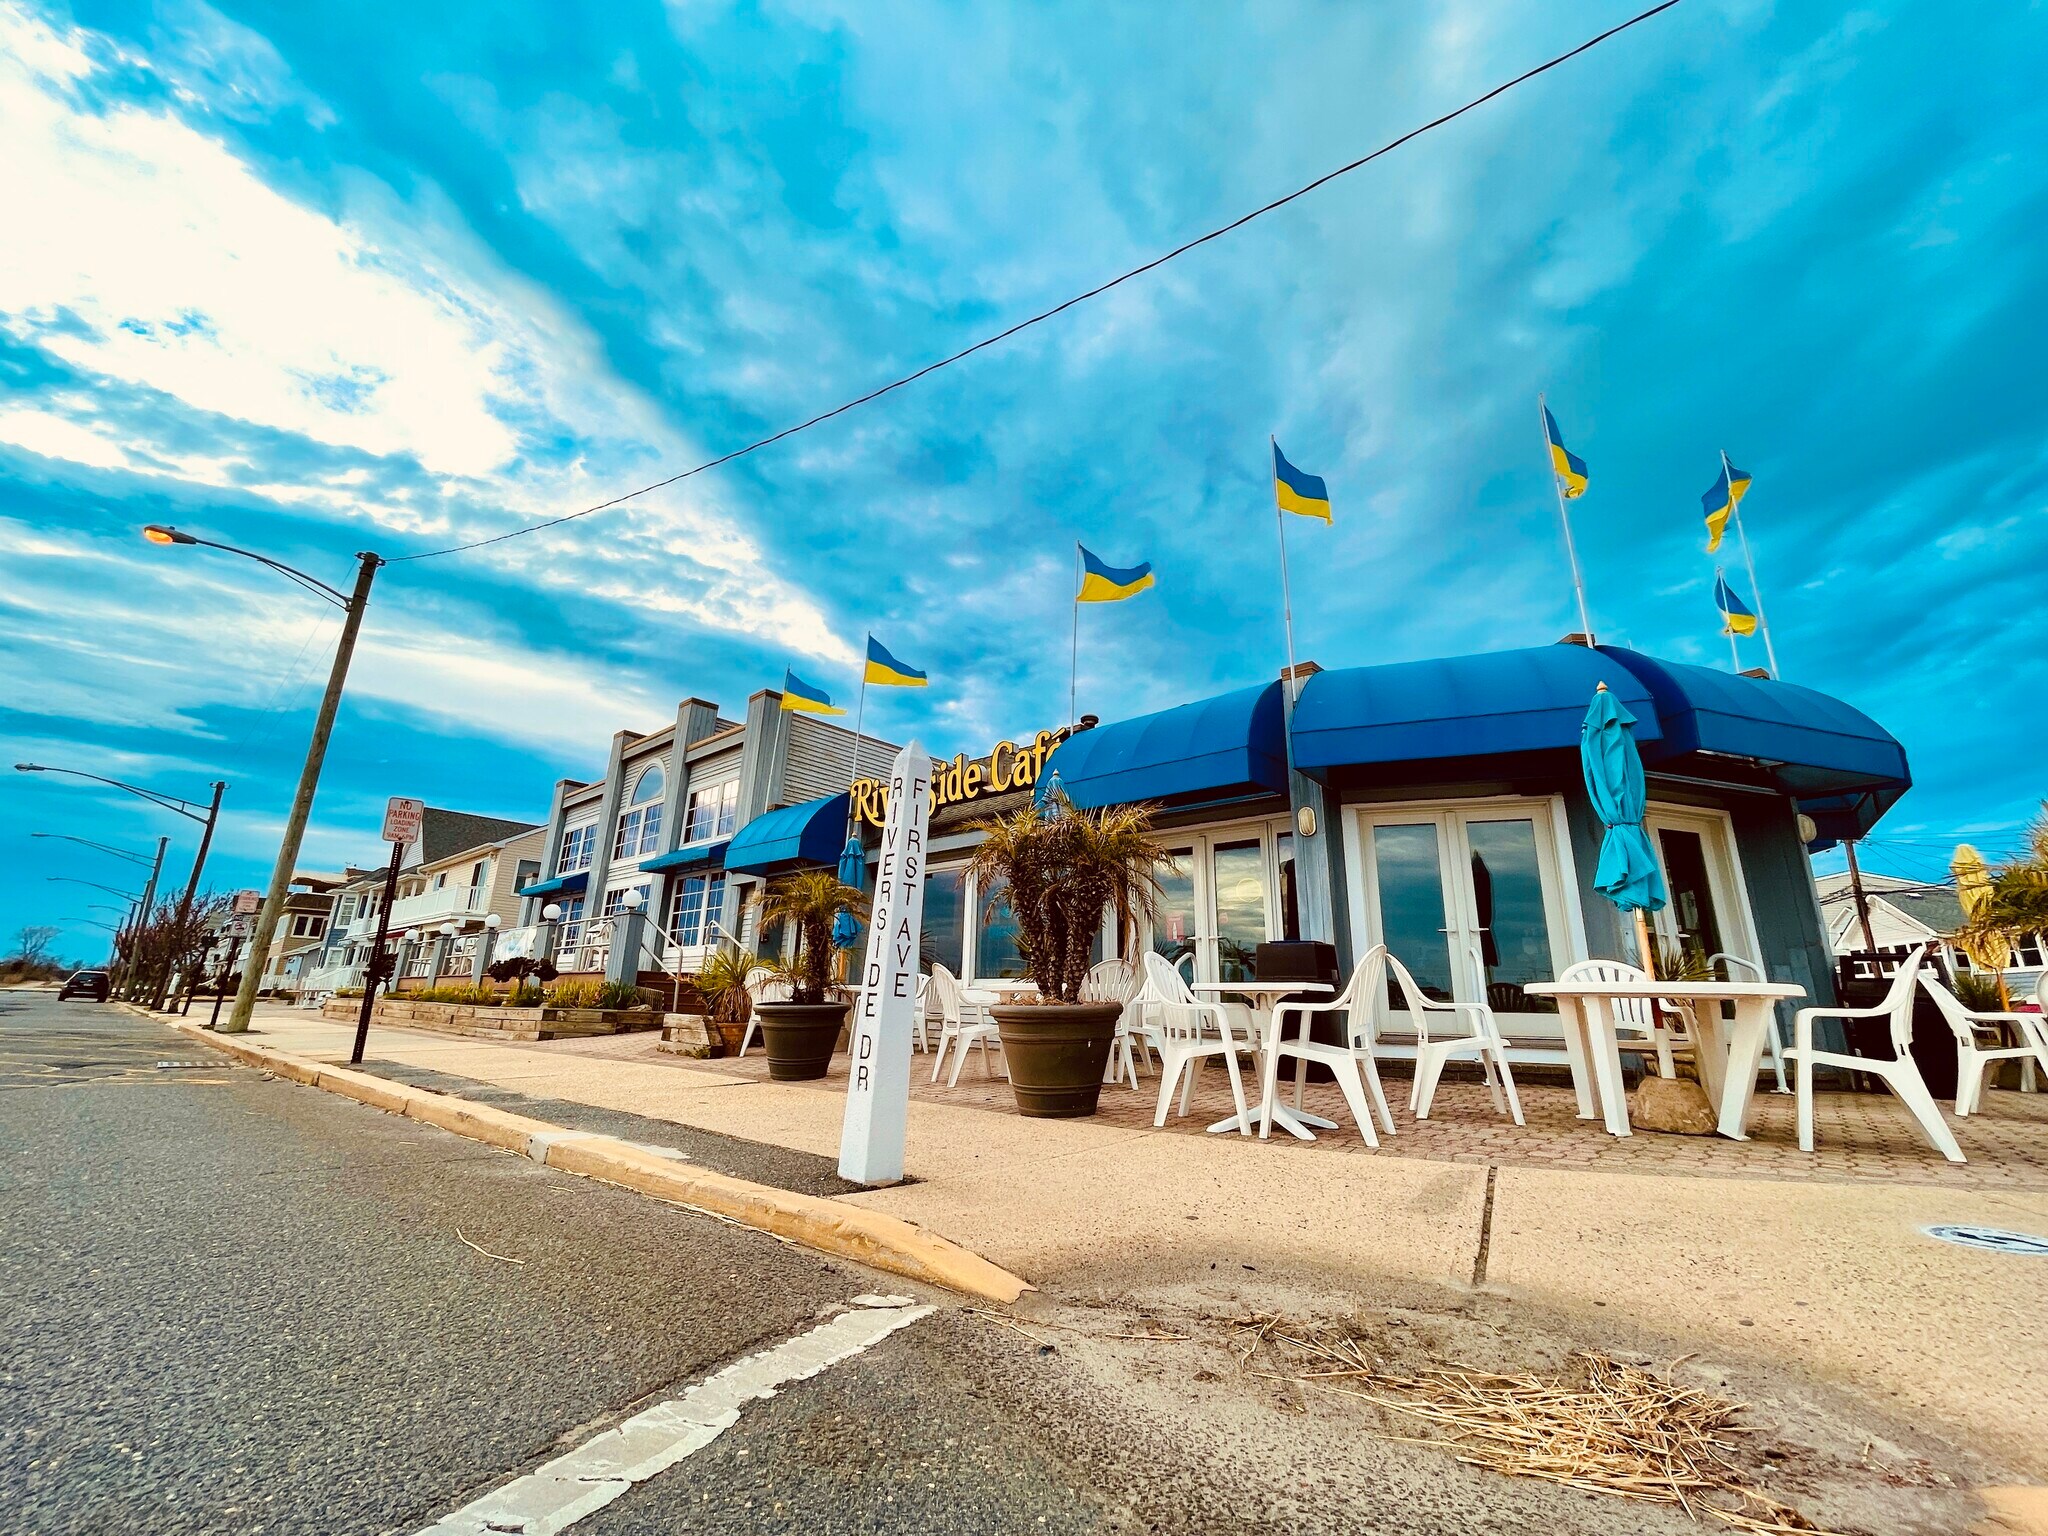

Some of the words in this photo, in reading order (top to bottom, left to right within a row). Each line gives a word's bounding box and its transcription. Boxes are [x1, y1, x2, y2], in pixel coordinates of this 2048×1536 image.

[388, 809, 421, 821] PARKING
[390, 819, 415, 827] LOADING
[399, 801, 412, 810] NO
[850, 752, 982, 828] Riide
[902, 778, 927, 906] FIRST
[865, 777, 903, 1018] RIVERSIDE
[893, 917, 912, 998] AVE
[857, 1034, 873, 1092] DR
